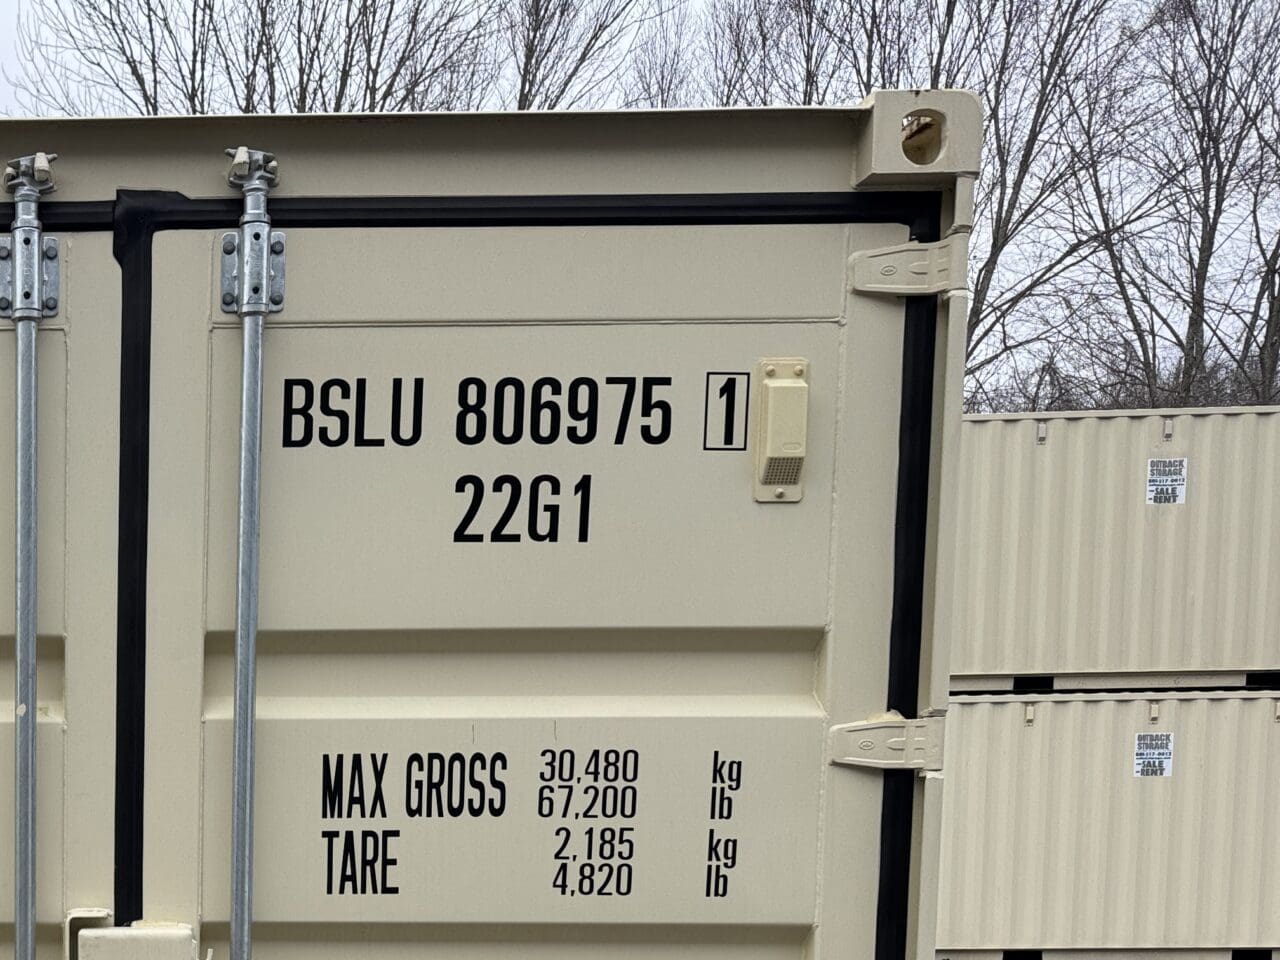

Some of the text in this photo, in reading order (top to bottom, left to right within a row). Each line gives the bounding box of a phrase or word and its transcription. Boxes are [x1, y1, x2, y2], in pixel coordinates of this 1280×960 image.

[282, 377, 424, 448] BSLU
[455, 376, 672, 446] 806975
[453, 474, 592, 543] 22G1
[1154, 495, 1179, 503] RENT
[1155, 487, 1177, 495] SALE
[1141, 768, 1165, 776] RENT
[1142, 760, 1164, 768] SALE
[321, 749, 742, 819] MAX GROSS 30,480 kg
[537, 785, 733, 820] 67,200 lb
[321, 827, 738, 895] TARE 2,185 kg
[552, 863, 729, 898] 4,820 lb
